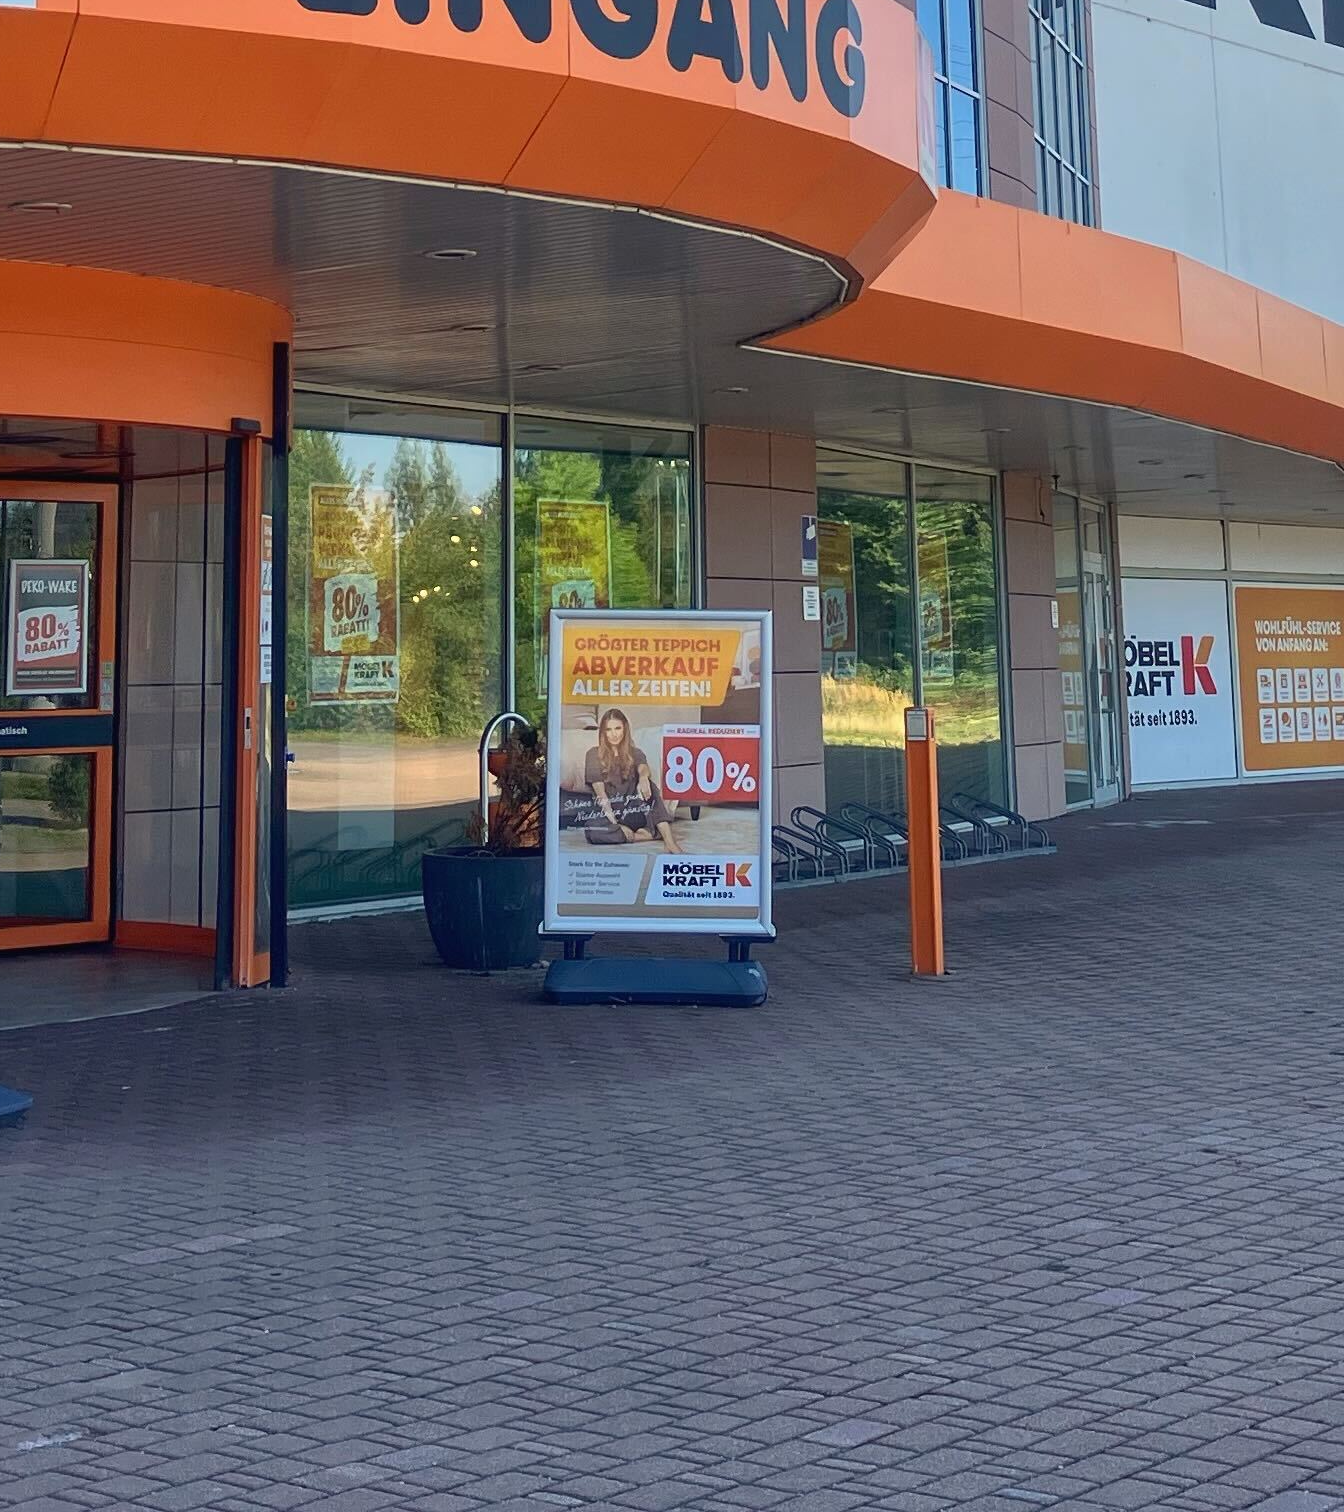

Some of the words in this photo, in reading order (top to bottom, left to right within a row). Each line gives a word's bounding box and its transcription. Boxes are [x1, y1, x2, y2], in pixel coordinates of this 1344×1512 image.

[332, 585, 369, 622] 80%
[25, 613, 69, 641] 80%
[1255, 617, 1341, 636] WOHLFÜHL-SERVICE
[24, 639, 69, 654] RABATT
[653, 639, 721, 652] TEPPICH
[1124, 635, 1180, 667] ÖBEL
[1256, 638, 1276, 652] VON
[1277, 638, 1312, 652] ANFANG
[572, 656, 719, 676] ABVERKAUF
[571, 679, 634, 697] ALLER
[637, 679, 711, 697] ZEITEN!
[1126, 671, 1175, 696] RAFT
[1147, 709, 1167, 726] seit
[1169, 709, 1198, 725] 1893.
[665, 746, 756, 794] 80%
[663, 862, 724, 875] MÖBEL
[663, 876, 720, 887] KRAFT
